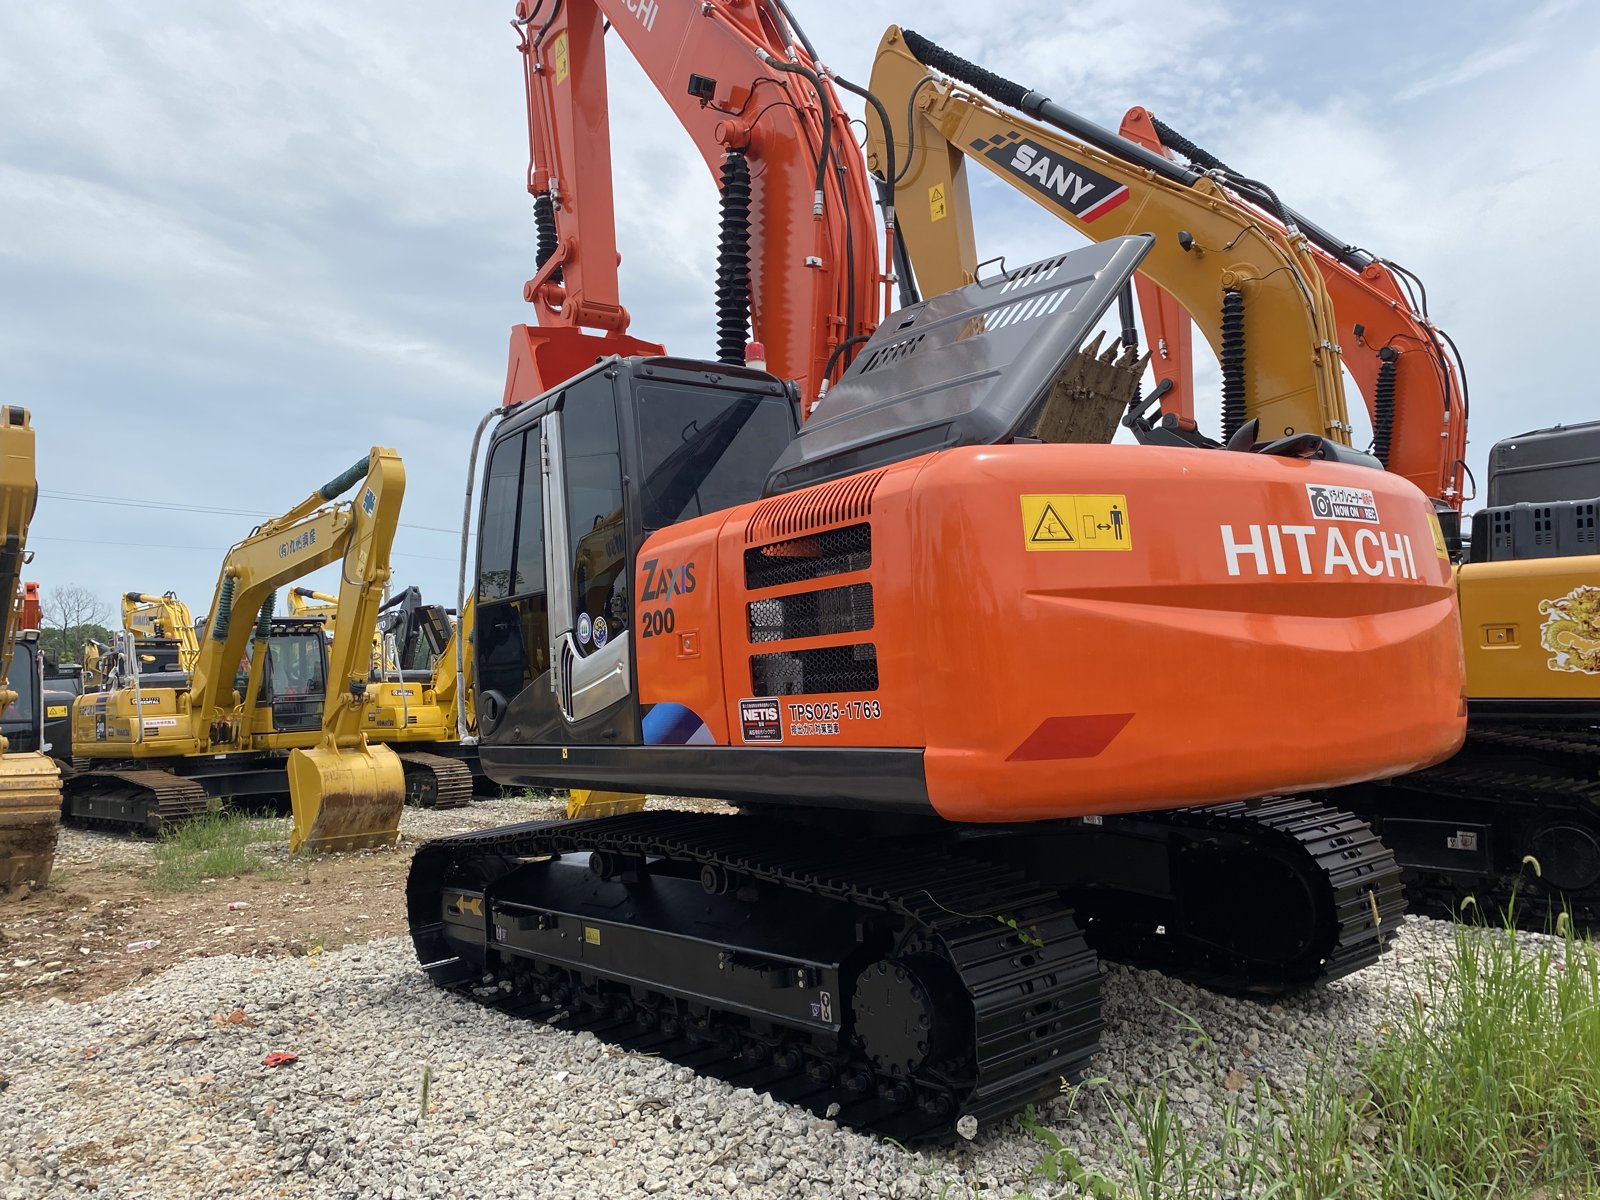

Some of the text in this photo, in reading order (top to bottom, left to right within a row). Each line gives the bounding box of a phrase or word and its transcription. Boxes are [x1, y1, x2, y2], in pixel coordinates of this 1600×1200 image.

[1010, 144, 1096, 205] SANY
[1333, 505, 1376, 520] NOW ON REC
[1220, 524, 1417, 580] HITACHI
[642, 607, 675, 638] 200
[743, 707, 778, 721] NETIS
